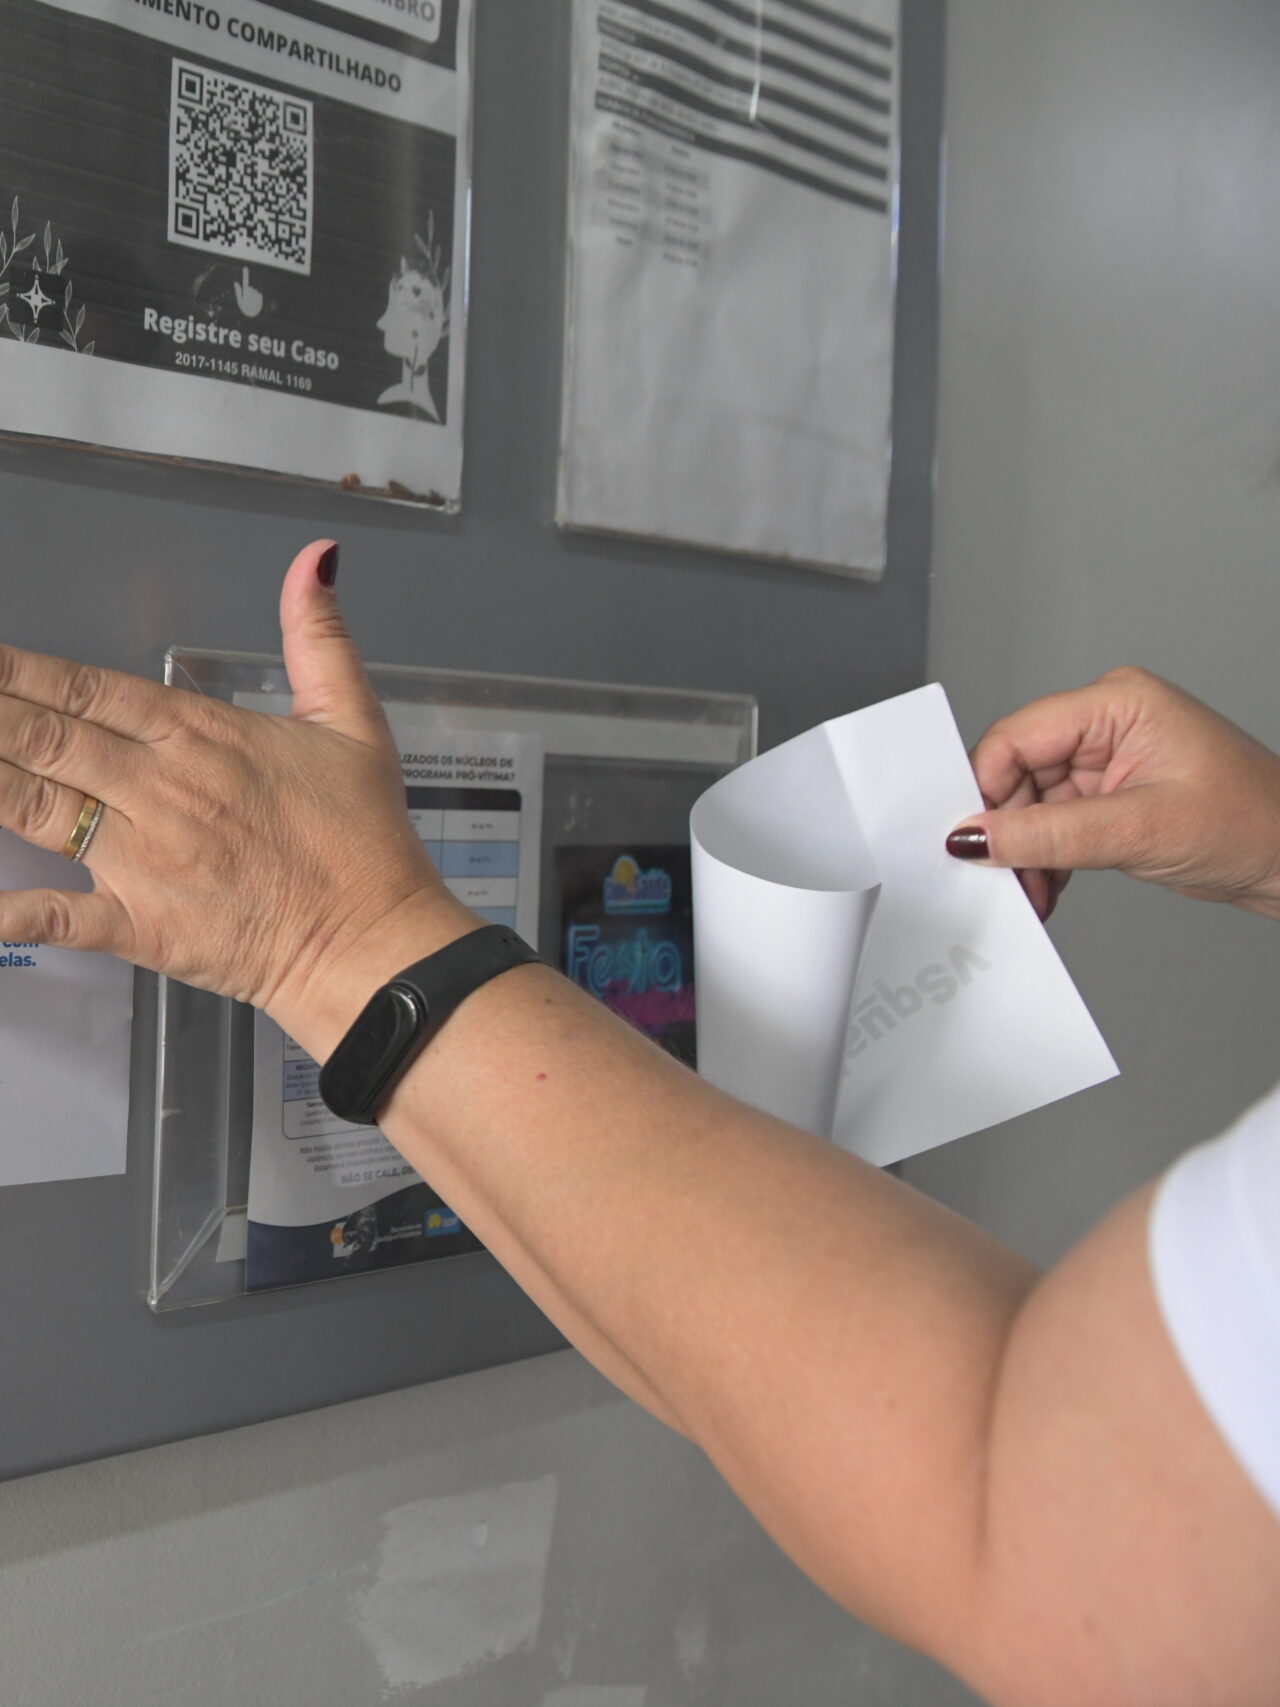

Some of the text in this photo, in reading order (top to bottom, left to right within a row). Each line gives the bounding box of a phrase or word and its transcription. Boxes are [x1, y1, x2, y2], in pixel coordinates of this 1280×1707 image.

[227, 17, 403, 93] COMPARTILHADO
[143, 307, 340, 370] Registre seu Caso
[175, 352, 312, 391] 2017-1145 RAMAL 1169
